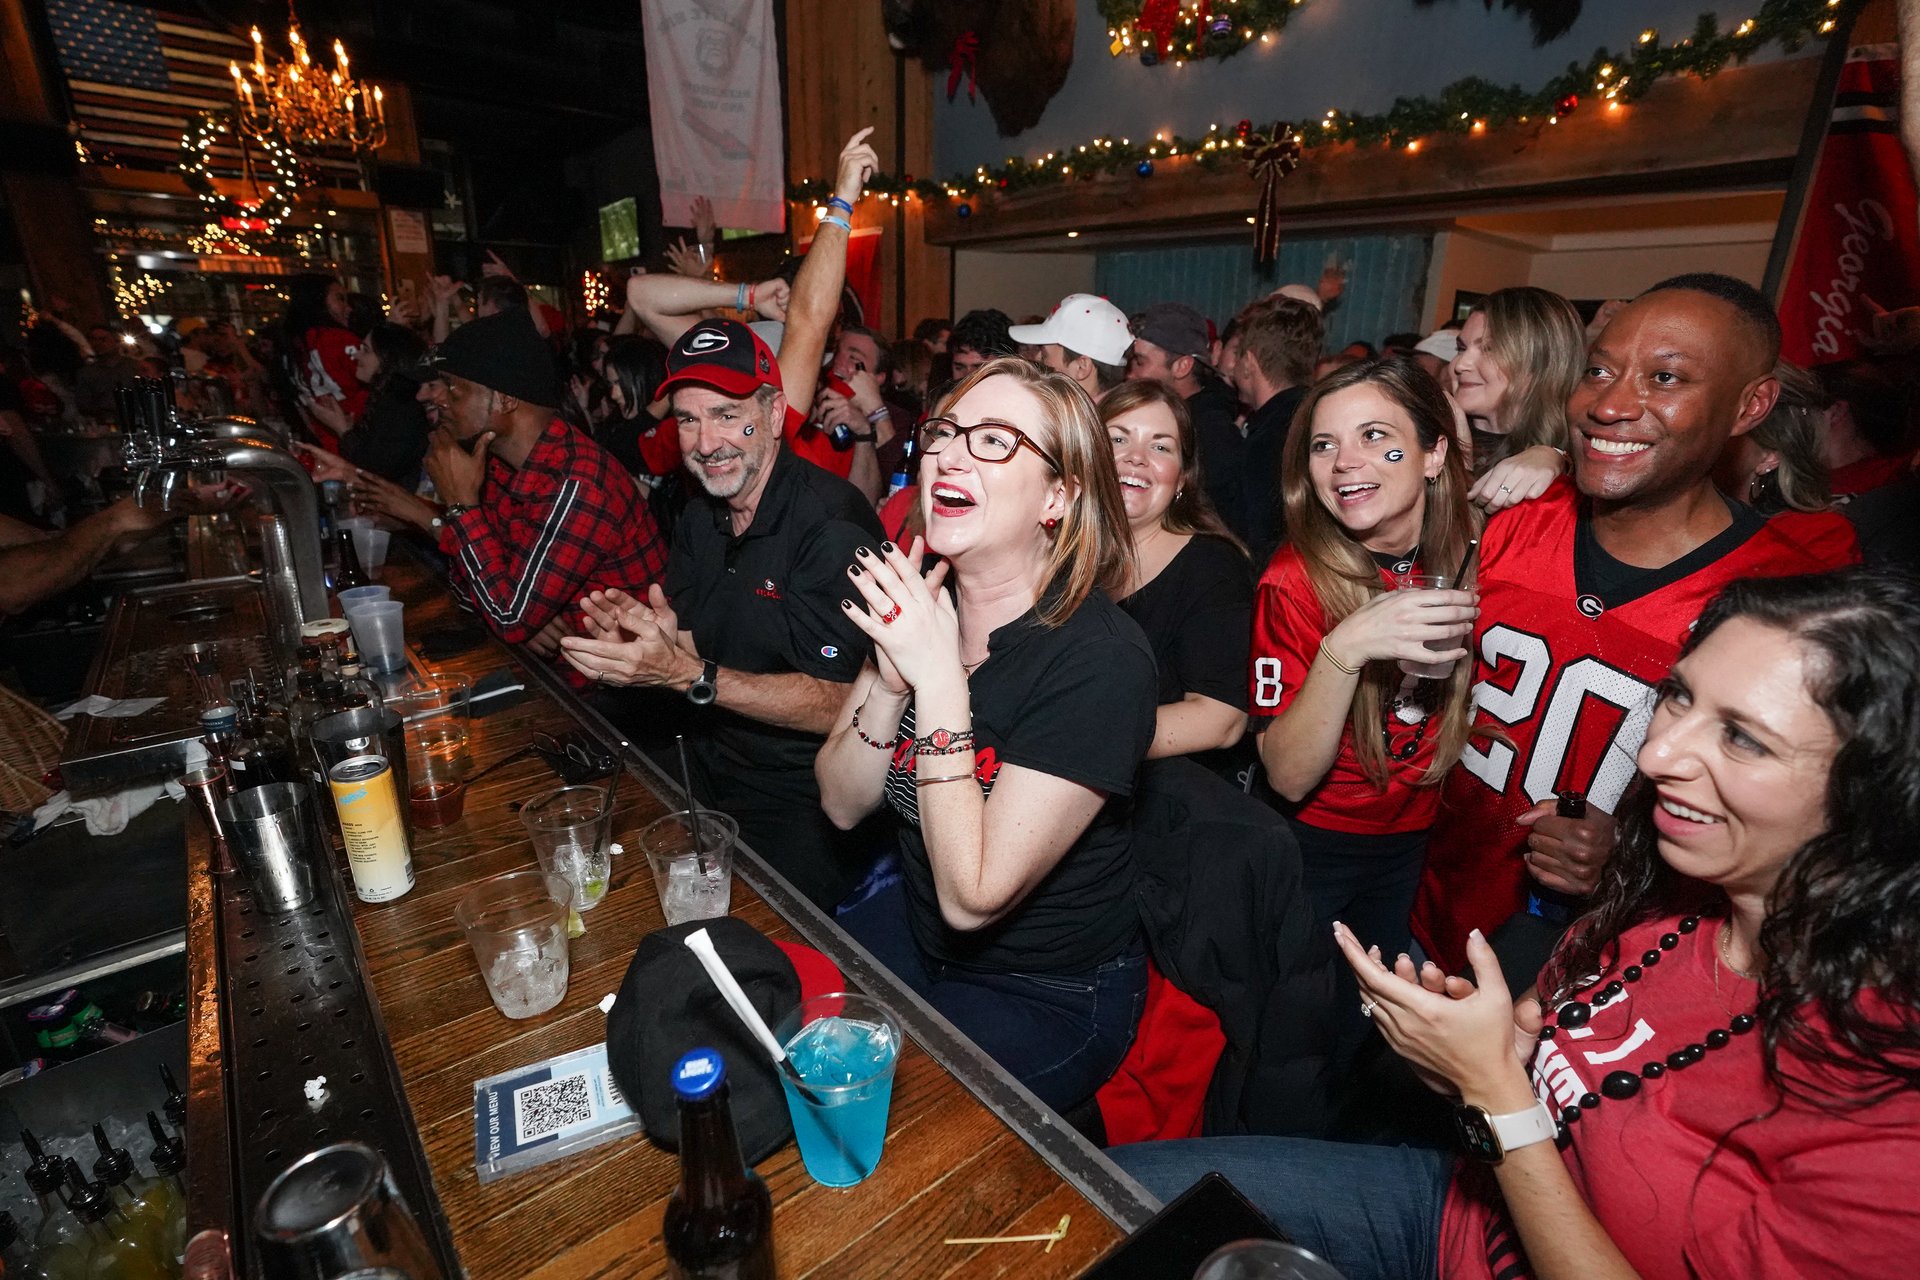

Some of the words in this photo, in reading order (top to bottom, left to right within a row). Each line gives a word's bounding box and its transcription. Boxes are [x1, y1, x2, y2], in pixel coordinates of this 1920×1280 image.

[1810, 198, 1893, 356] Georgia
[1255, 656, 1283, 707] 8
[1459, 622, 1658, 815] 20
[488, 1091, 499, 1116] MENU
[489, 1115, 500, 1135] OUR
[489, 1135, 500, 1159] VIEW
